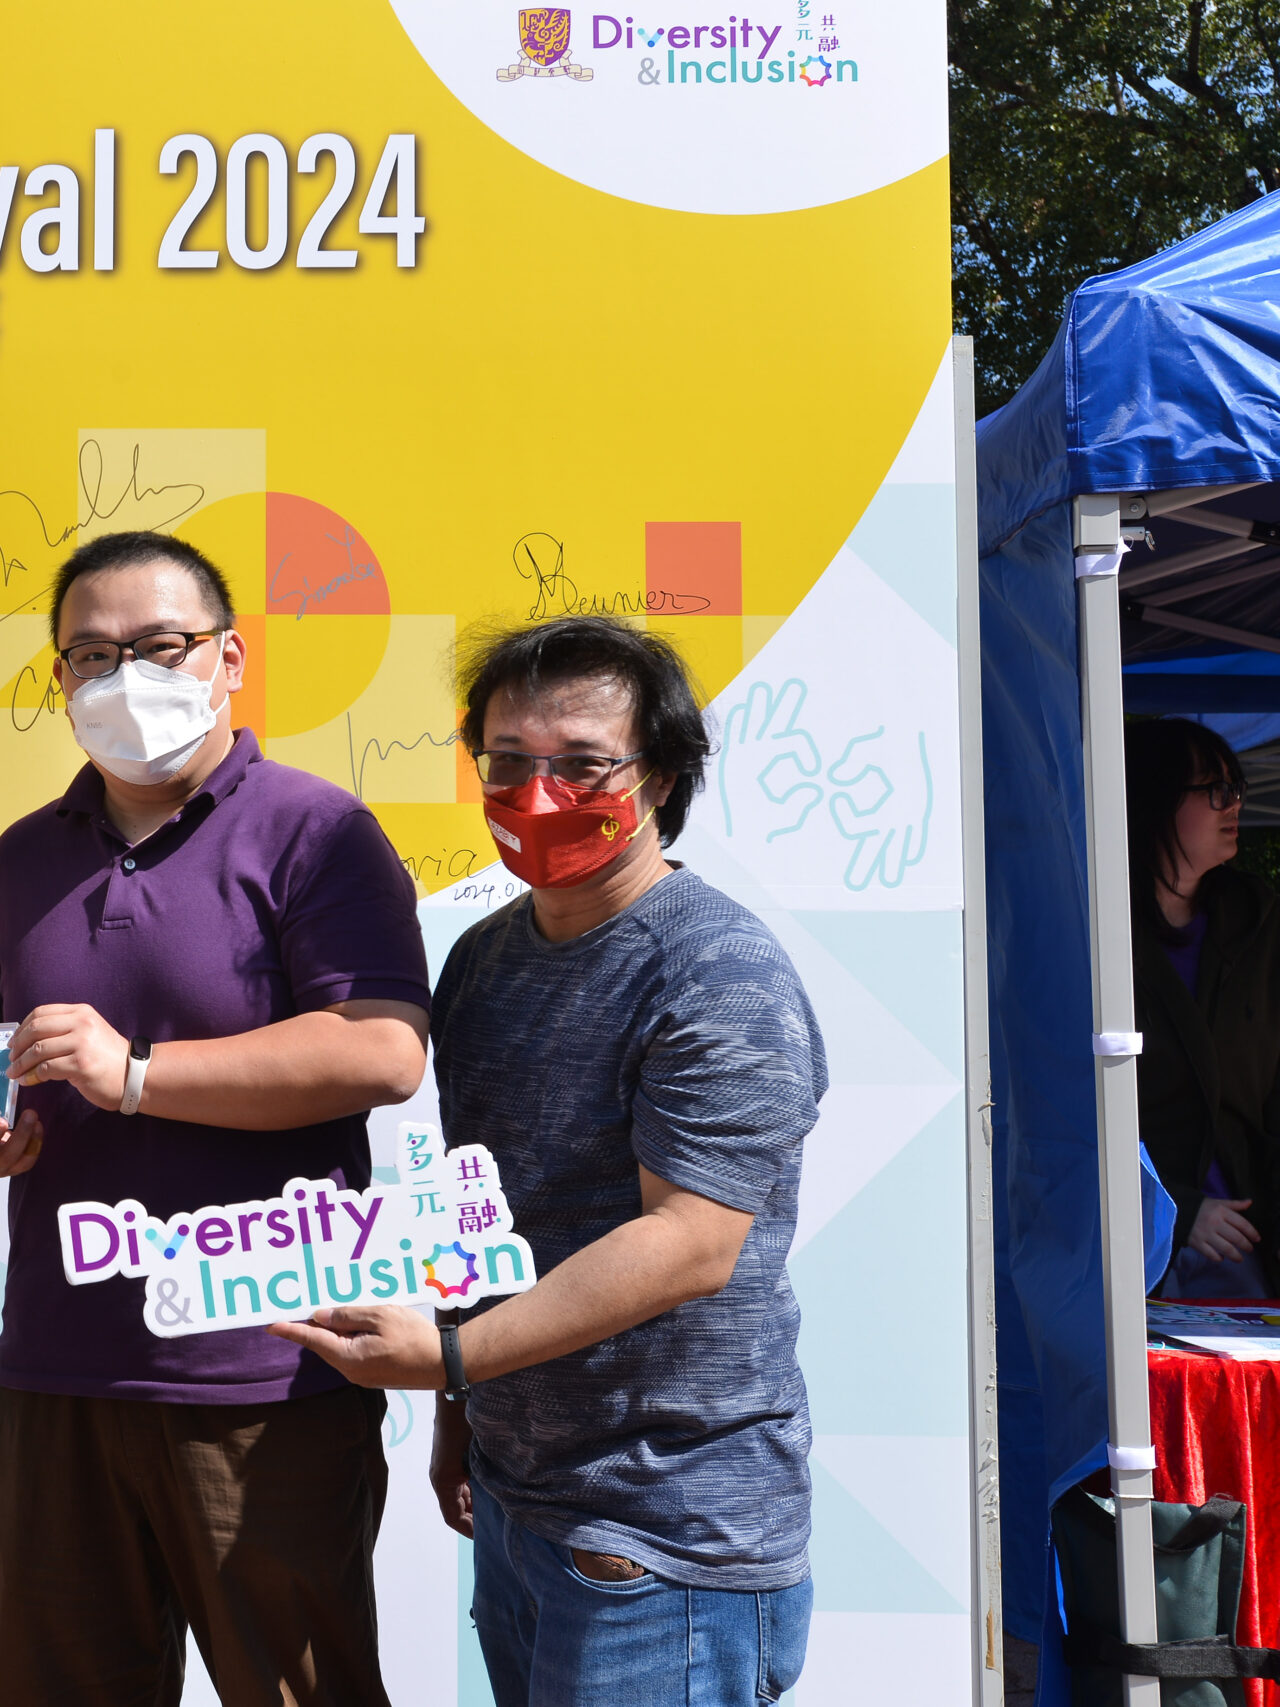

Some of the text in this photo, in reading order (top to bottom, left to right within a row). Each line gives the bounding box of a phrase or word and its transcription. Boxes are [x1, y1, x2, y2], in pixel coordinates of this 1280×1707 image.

[593, 15, 782, 60] Diversity
[818, 14, 841, 52] 共融
[158, 132, 426, 270] 2024
[406, 1132, 446, 1218] 多元
[456, 1156, 502, 1235] 共融
[68, 1189, 384, 1273] Diversity
